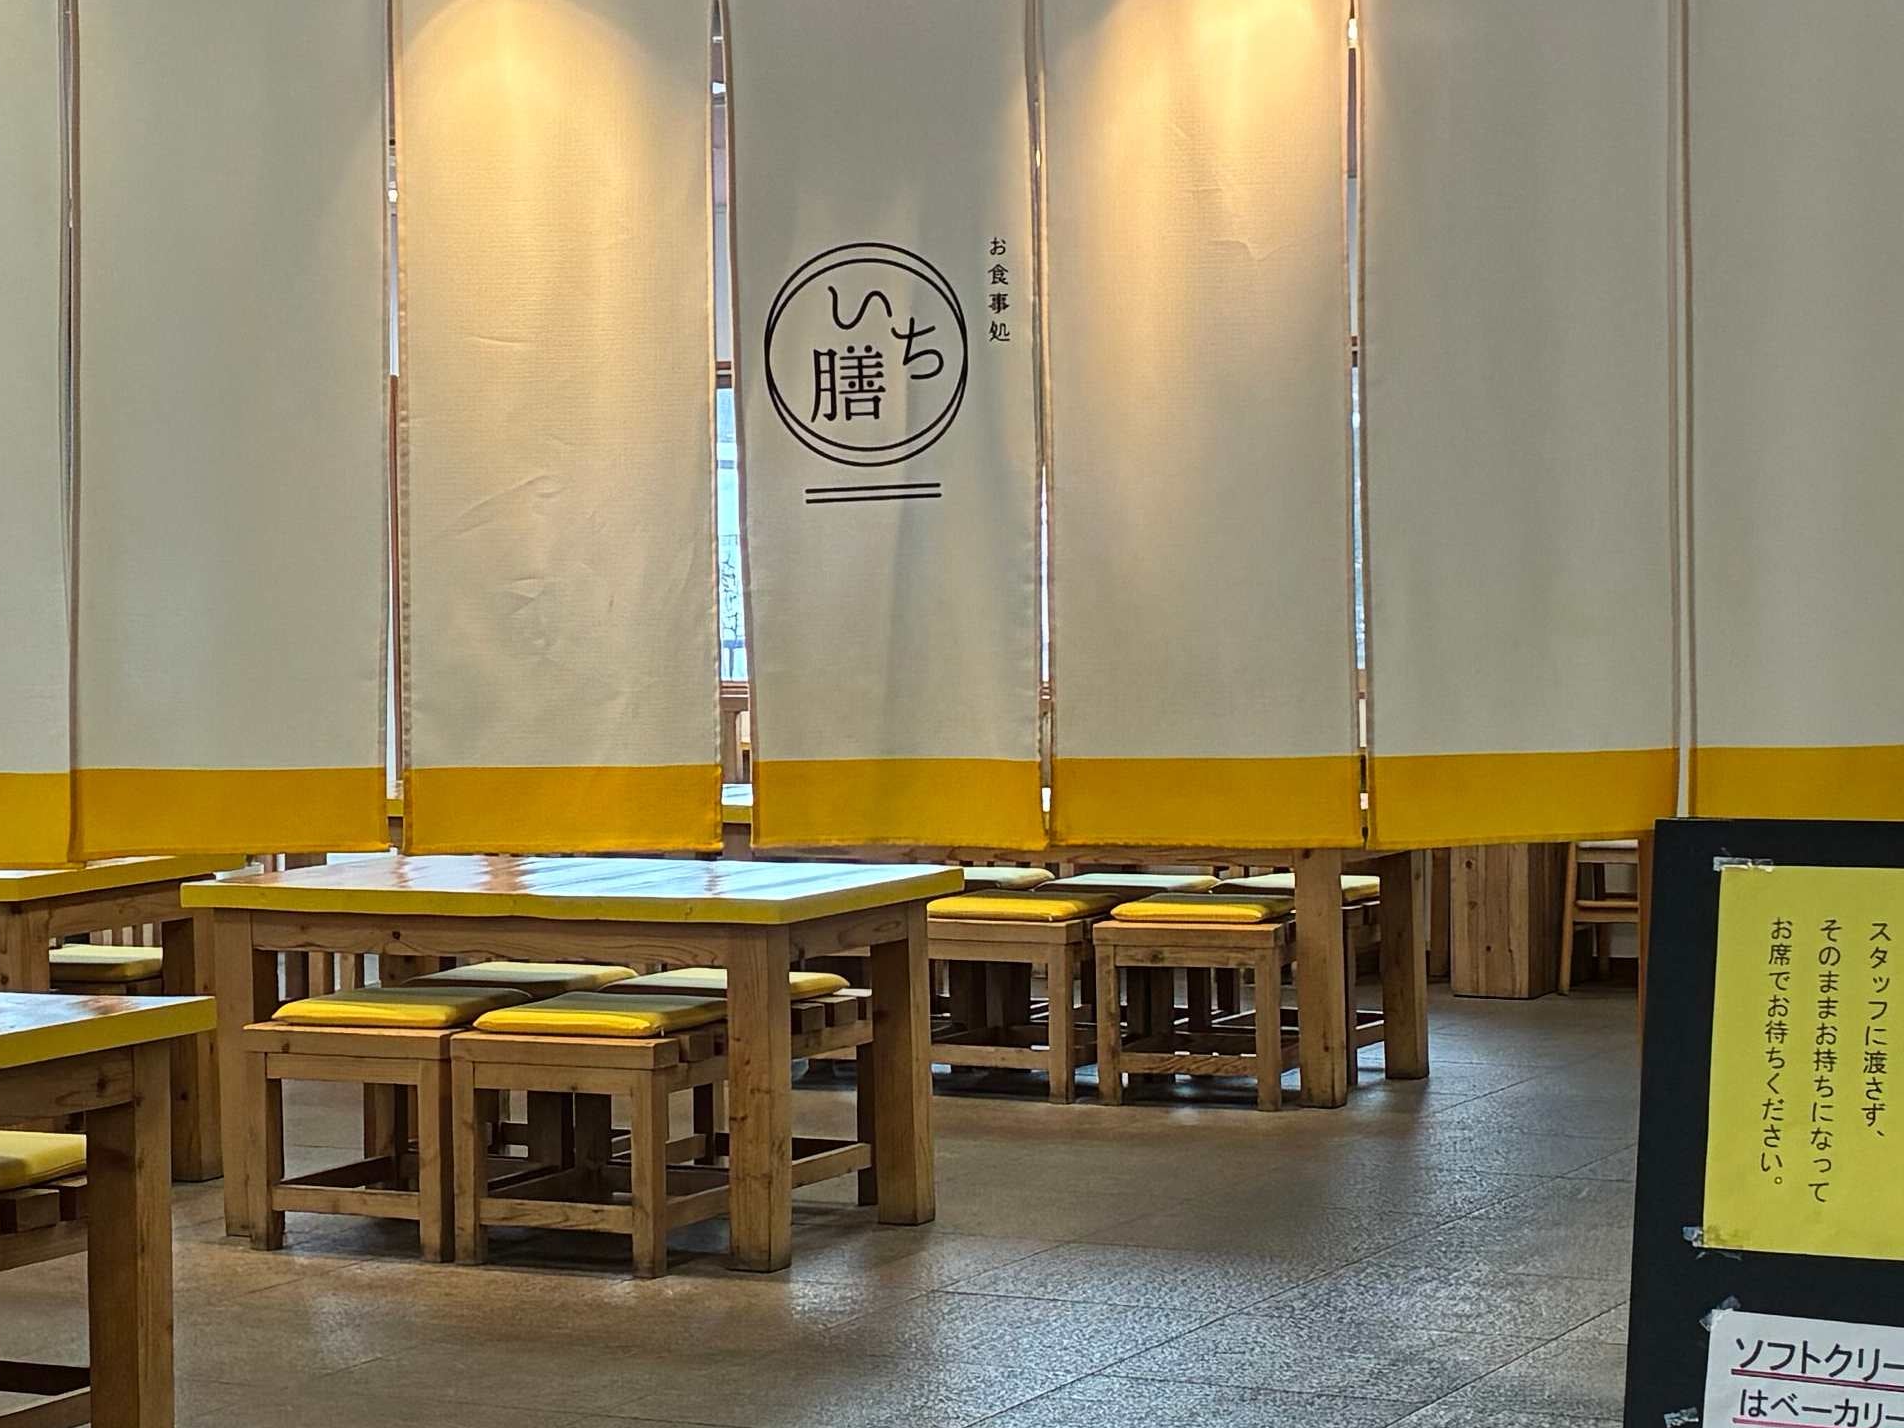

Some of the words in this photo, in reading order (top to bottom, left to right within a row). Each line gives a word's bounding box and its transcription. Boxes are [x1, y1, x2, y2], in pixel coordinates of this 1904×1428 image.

[812, 285, 944, 422] いち膳
[988, 237, 1010, 342] お食事処
[1761, 917, 1793, 1186] お席でお待ちください。
[1809, 919, 1842, 1203] そのままお持ちになって
[1862, 922, 1891, 1137] スタッフに渡さず、
